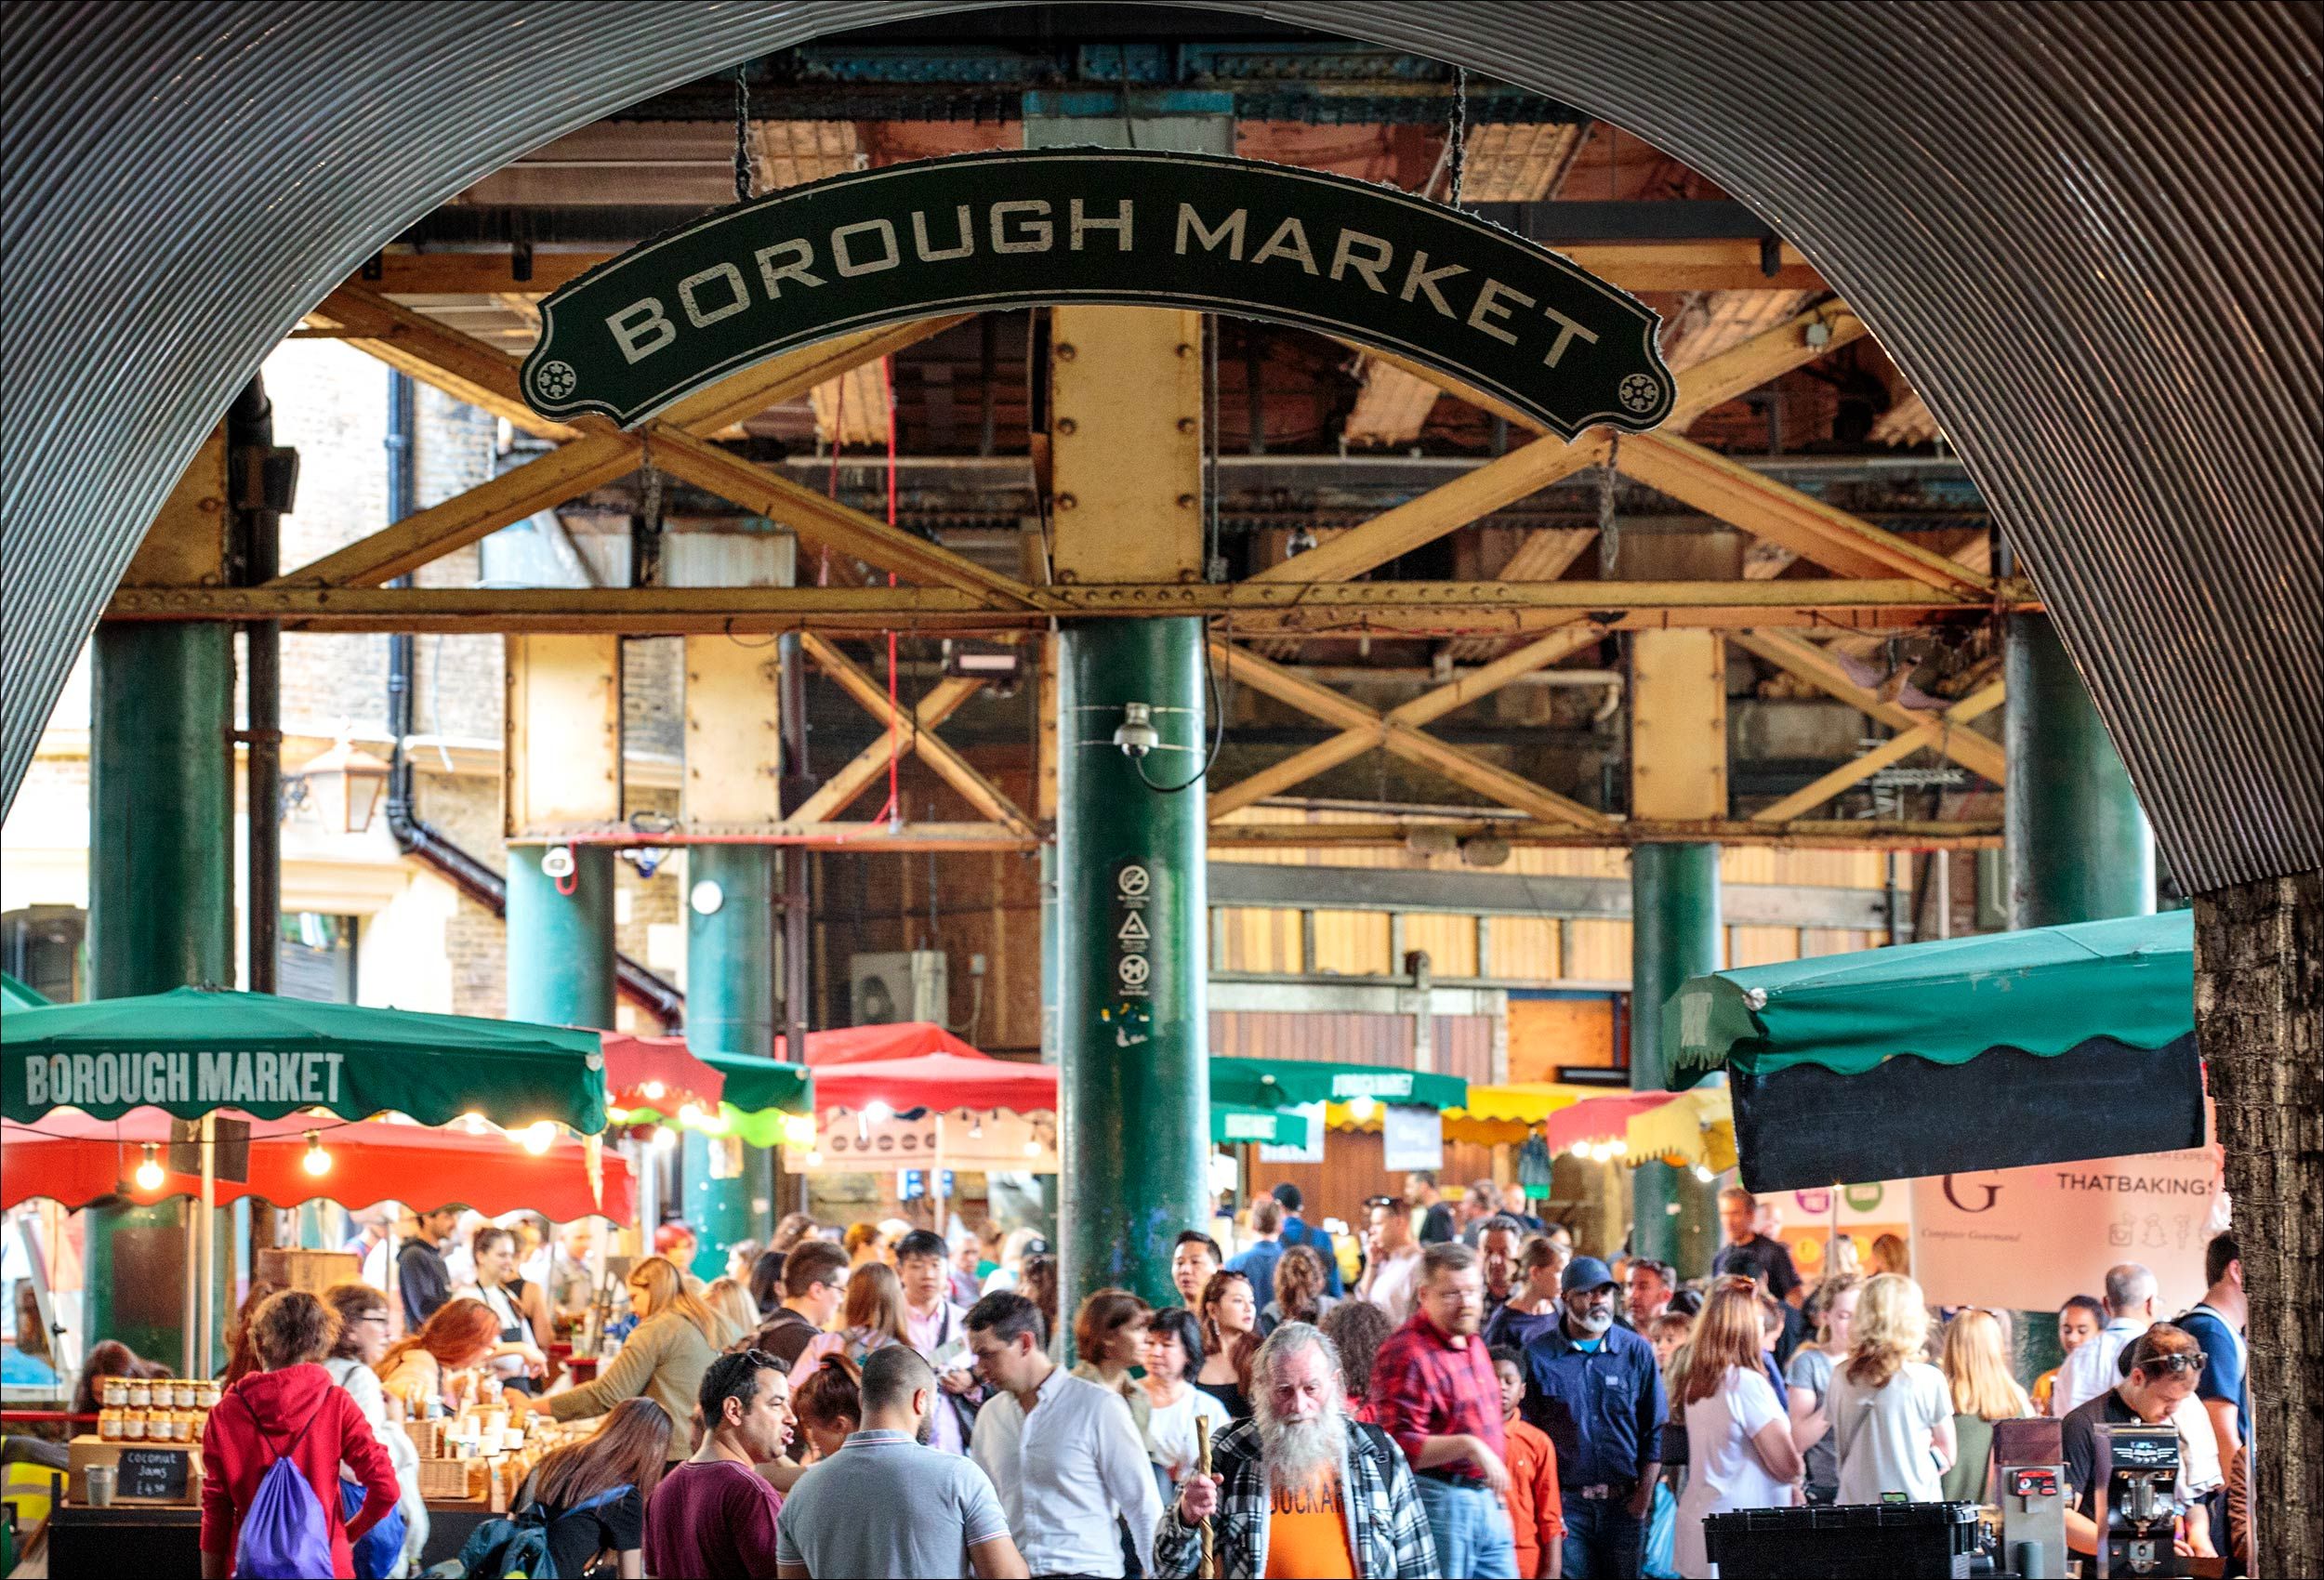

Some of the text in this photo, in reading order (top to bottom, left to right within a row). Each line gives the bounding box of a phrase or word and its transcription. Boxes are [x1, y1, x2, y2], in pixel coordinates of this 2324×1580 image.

[604, 198, 1600, 369] BOROUGH MARKET
[25, 1051, 345, 1106] BOROUGH MARKET
